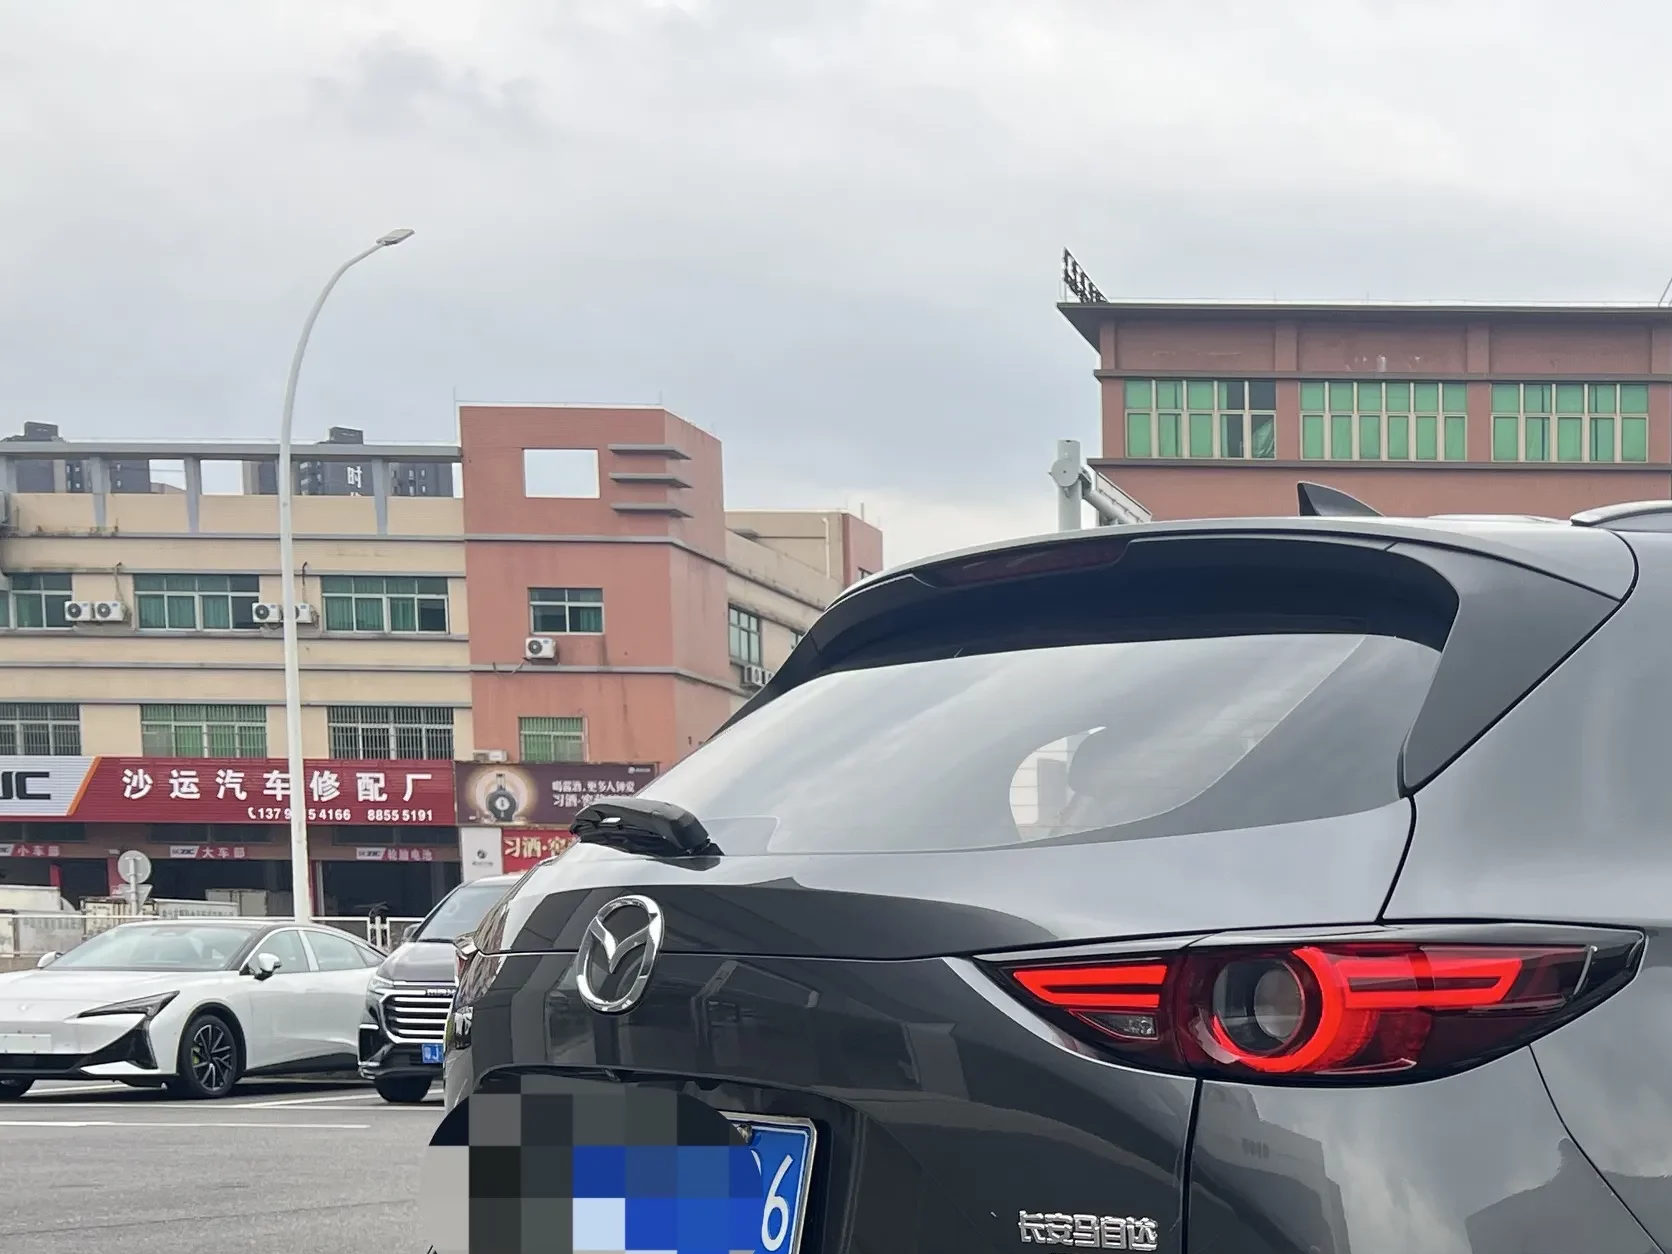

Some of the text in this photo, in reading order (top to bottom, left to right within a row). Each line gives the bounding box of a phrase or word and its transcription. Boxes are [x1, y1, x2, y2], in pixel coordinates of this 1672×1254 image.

[347, 465, 363, 496] 时
[0, 771, 50, 800] IC
[122, 768, 432, 802] 沙运汽车修配厂
[503, 836, 577, 858] 习酒·窖
[1018, 1210, 1158, 1251] 长安马自达
